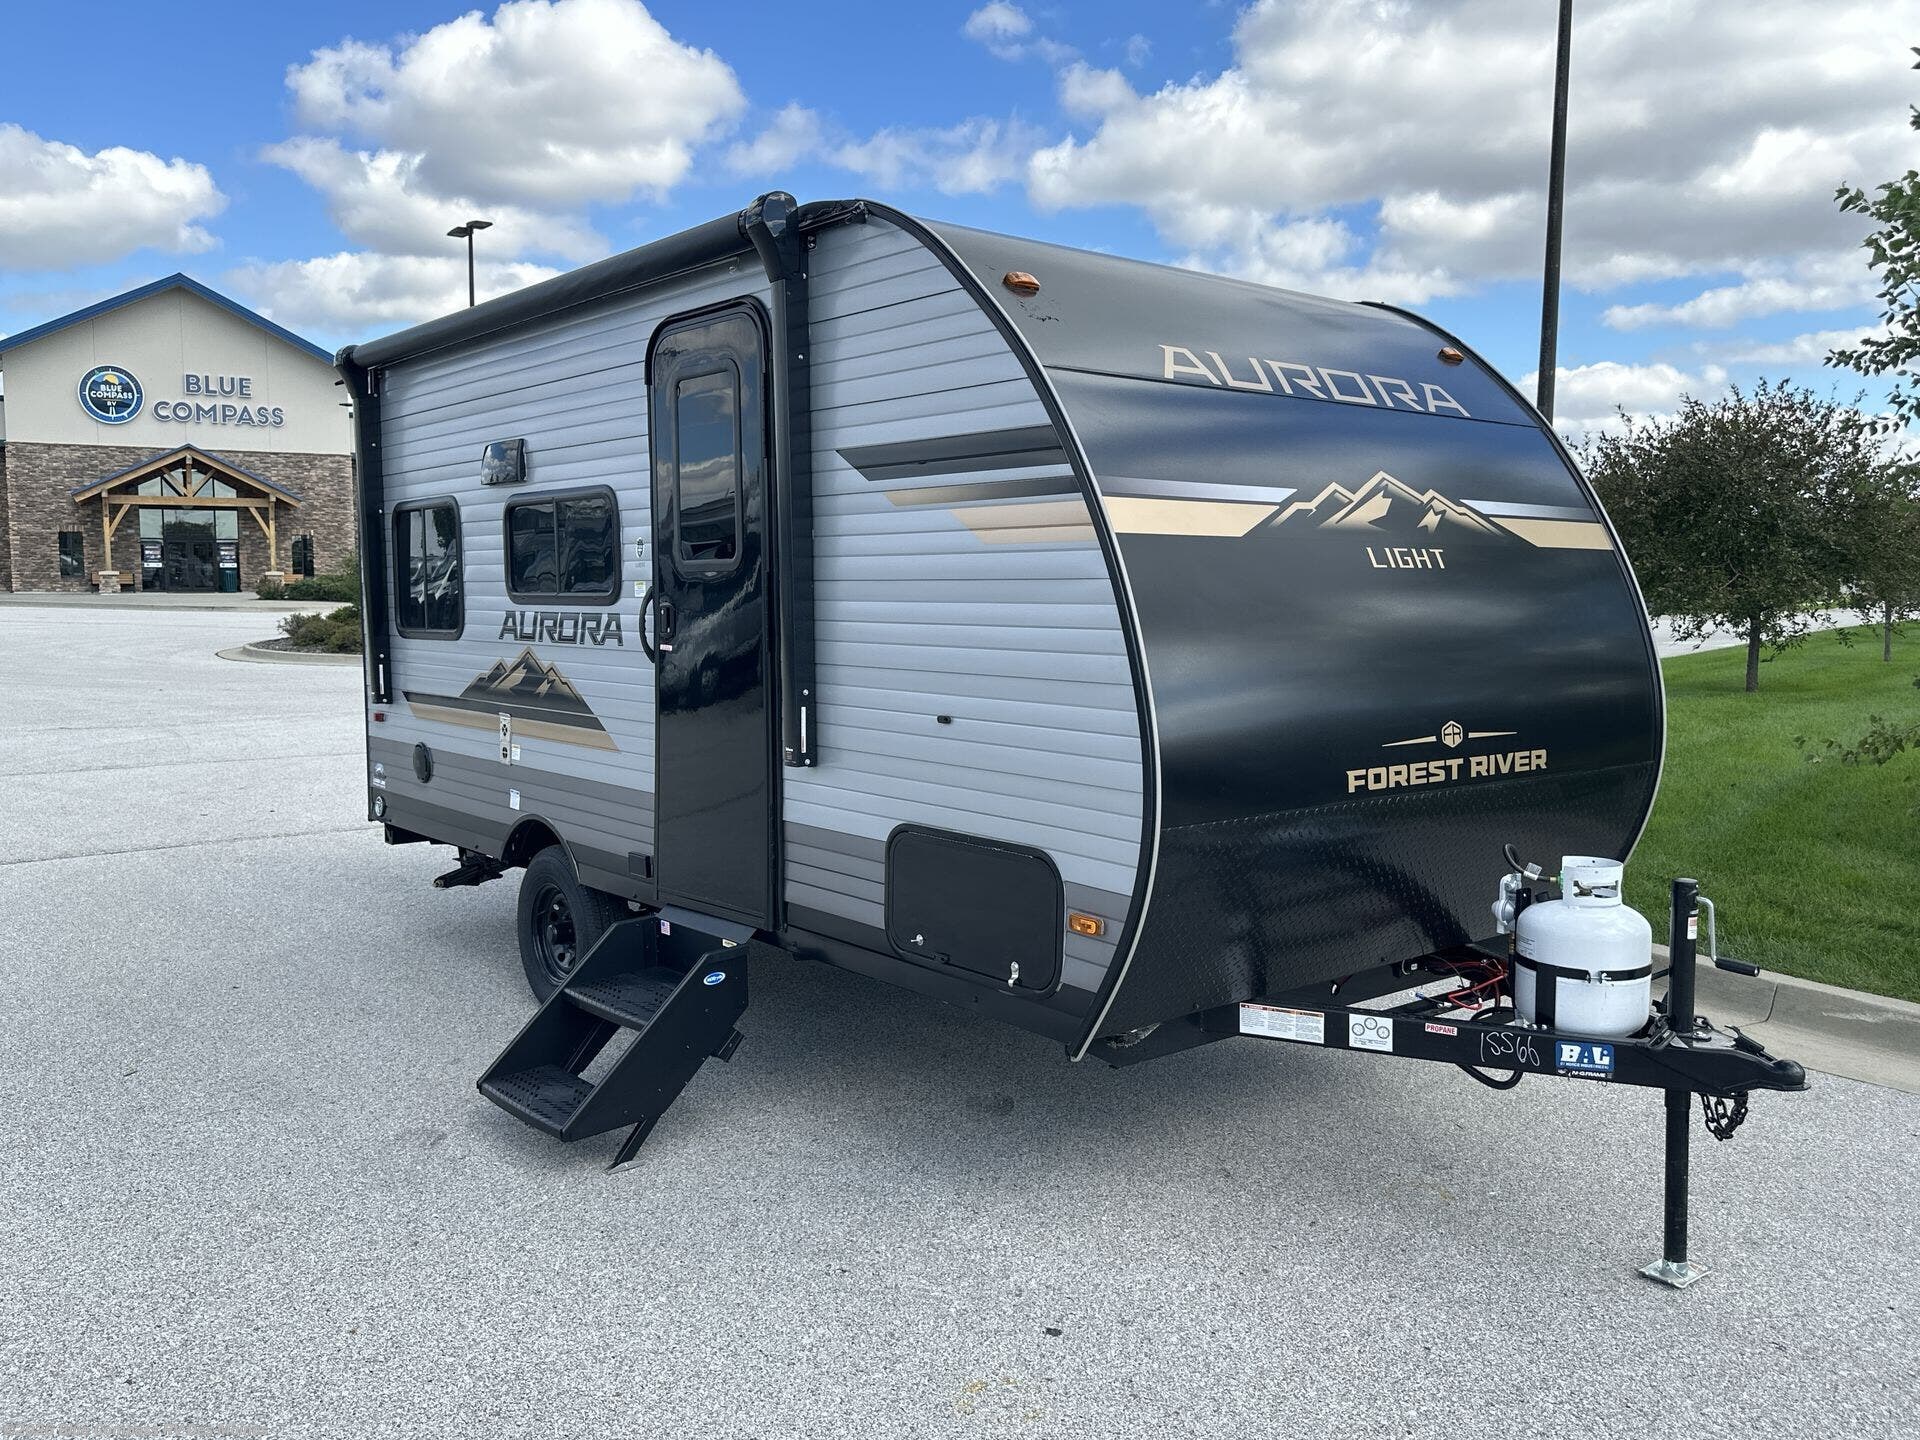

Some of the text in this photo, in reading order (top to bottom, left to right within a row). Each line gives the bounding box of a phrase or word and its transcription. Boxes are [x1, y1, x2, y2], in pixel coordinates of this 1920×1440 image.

[100, 384, 122, 392] BLUE
[184, 373, 252, 398] BLUE
[1158, 344, 1471, 417] AURORA
[90, 390, 133, 399] COMPASS
[152, 400, 285, 426] COMPASS
[1366, 546, 1446, 569] LIGHT
[498, 610, 624, 646] AURORA
[1346, 749, 1548, 794] FOREST RIVER
[1426, 1023, 1456, 1035] PROPANE
